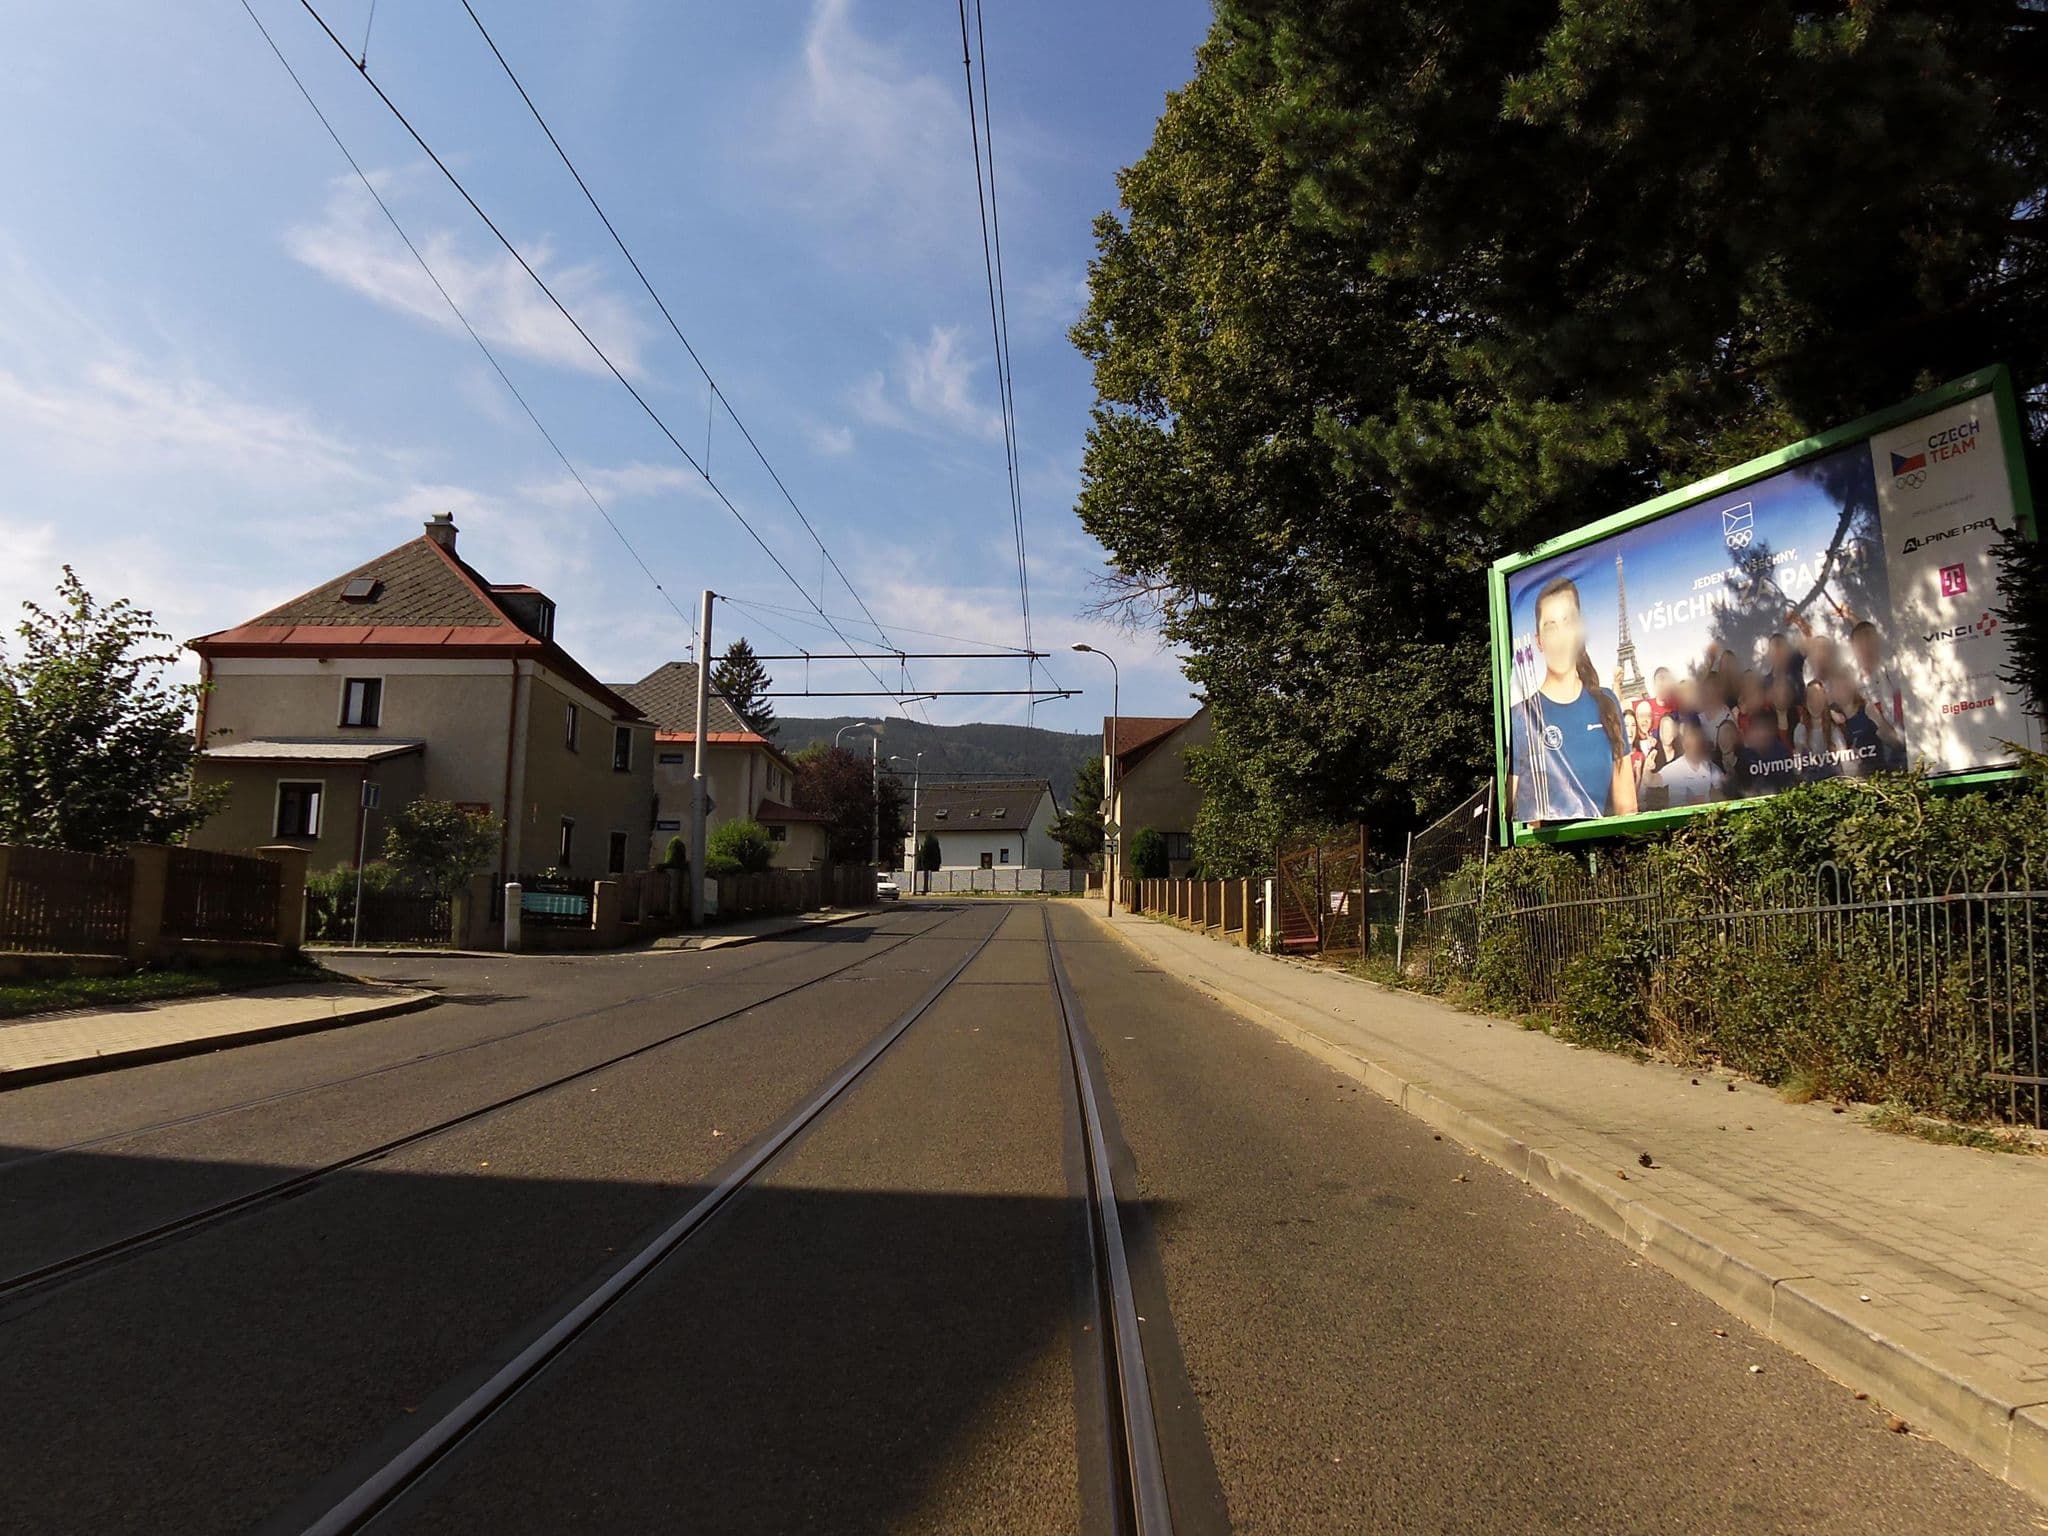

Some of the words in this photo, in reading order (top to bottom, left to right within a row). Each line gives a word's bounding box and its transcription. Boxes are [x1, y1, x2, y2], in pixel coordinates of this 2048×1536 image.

[1928, 420, 1980, 448] CZECH
[1930, 437, 1975, 463] TEAM
[1903, 528, 1960, 554] ALPINE
[1963, 517, 1995, 534] PRO
[1692, 571, 1725, 590] JEDEN
[1727, 566, 1743, 578] ZA
[1638, 586, 1731, 633] VŠICHNI
[1923, 625, 1972, 643] VINCI
[1942, 696, 1995, 714] BigBoard
[1749, 744, 1877, 776] olympijskytym.cz
